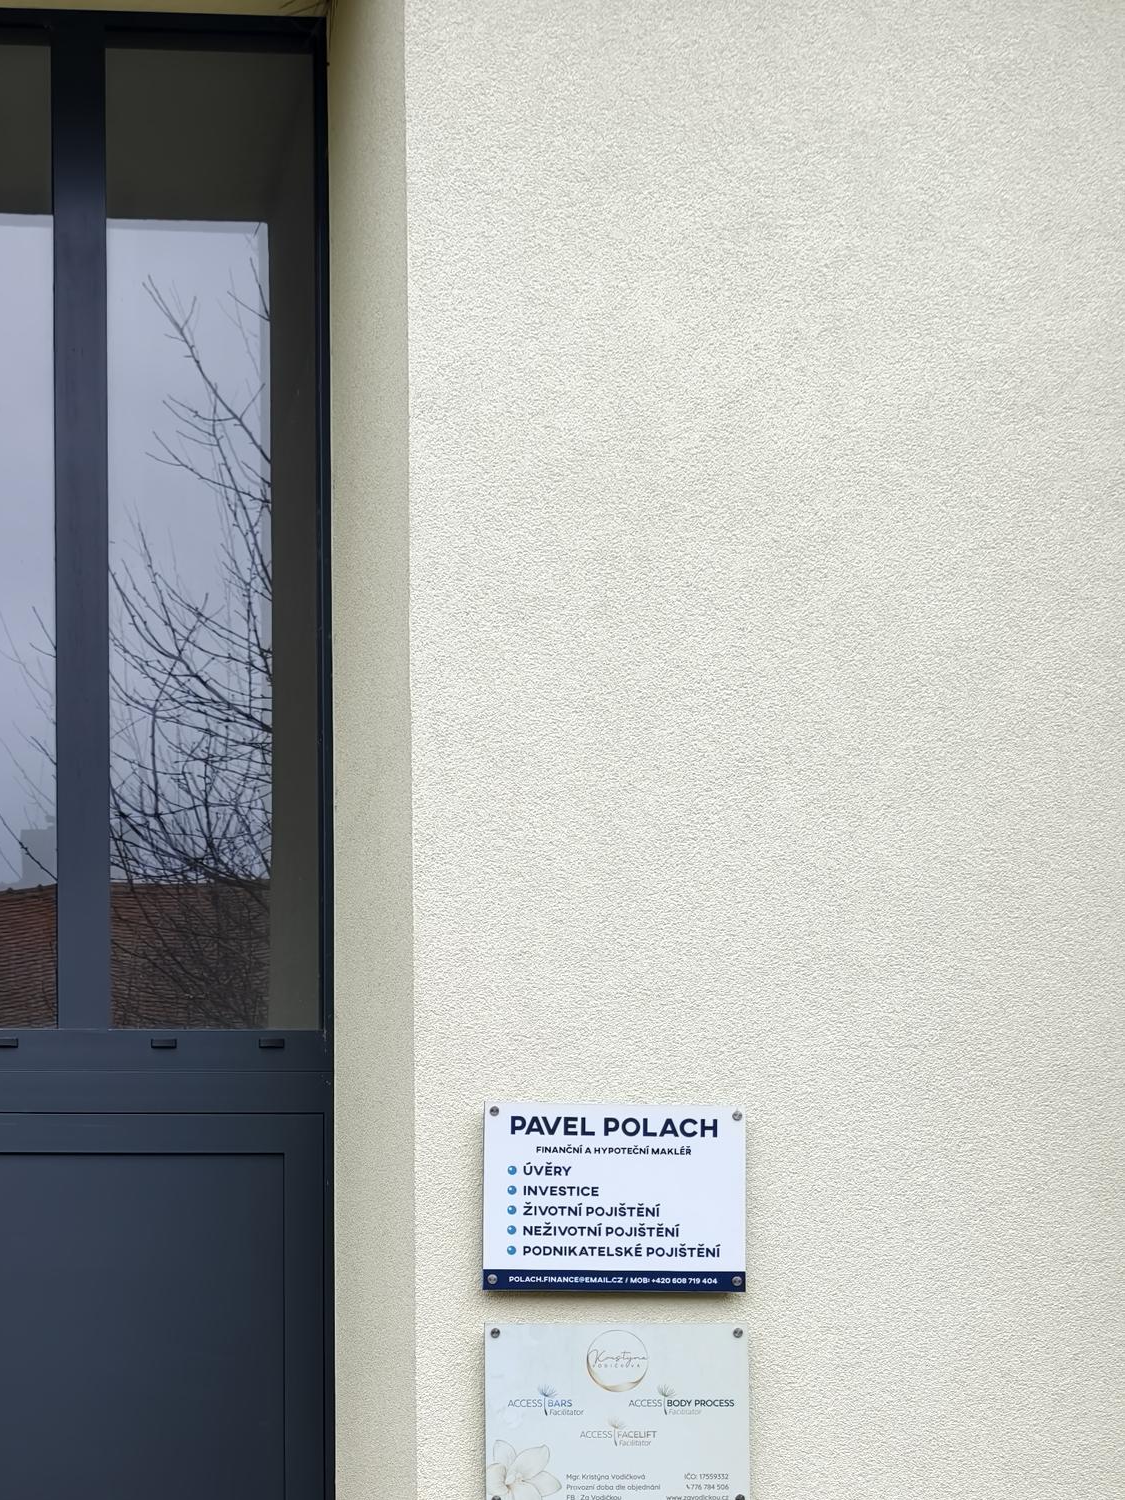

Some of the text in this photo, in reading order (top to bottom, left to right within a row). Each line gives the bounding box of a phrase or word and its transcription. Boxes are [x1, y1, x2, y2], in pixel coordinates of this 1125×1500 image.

[510, 1115, 718, 1138] PAVEL POLACH
[536, 1144, 583, 1154] FINANČNÍ
[594, 1145, 649, 1155] HYPOTEČNÍ
[651, 1146, 692, 1156] MAKLÉŘ
[523, 1162, 572, 1176] ÚVĚRY
[523, 1185, 600, 1197] INVESTICE
[523, 1201, 660, 1217] ŽIVOTNÍ POJIŠTĚNÍ
[523, 1221, 680, 1238] NEŽIVOTNÍ POJIŠTĚNÍ
[523, 1243, 721, 1258] PODNIKATELSKÉ POJIŠTĚNÍ
[508, 1276, 623, 1284] POLACH.FINANCE@EMAIL.CZ
[507, 1399, 573, 1407] ACCESS BARS
[628, 1399, 735, 1407] ACCESS BODY PROCESS
[549, 1408, 584, 1416] Facilitator
[579, 1430, 657, 1438] ACCESS FACELIFT
[619, 1439, 652, 1447] Facilitator
[581, 1473, 610, 1481] Kristýna
[627, 1484, 661, 1492] objednání
